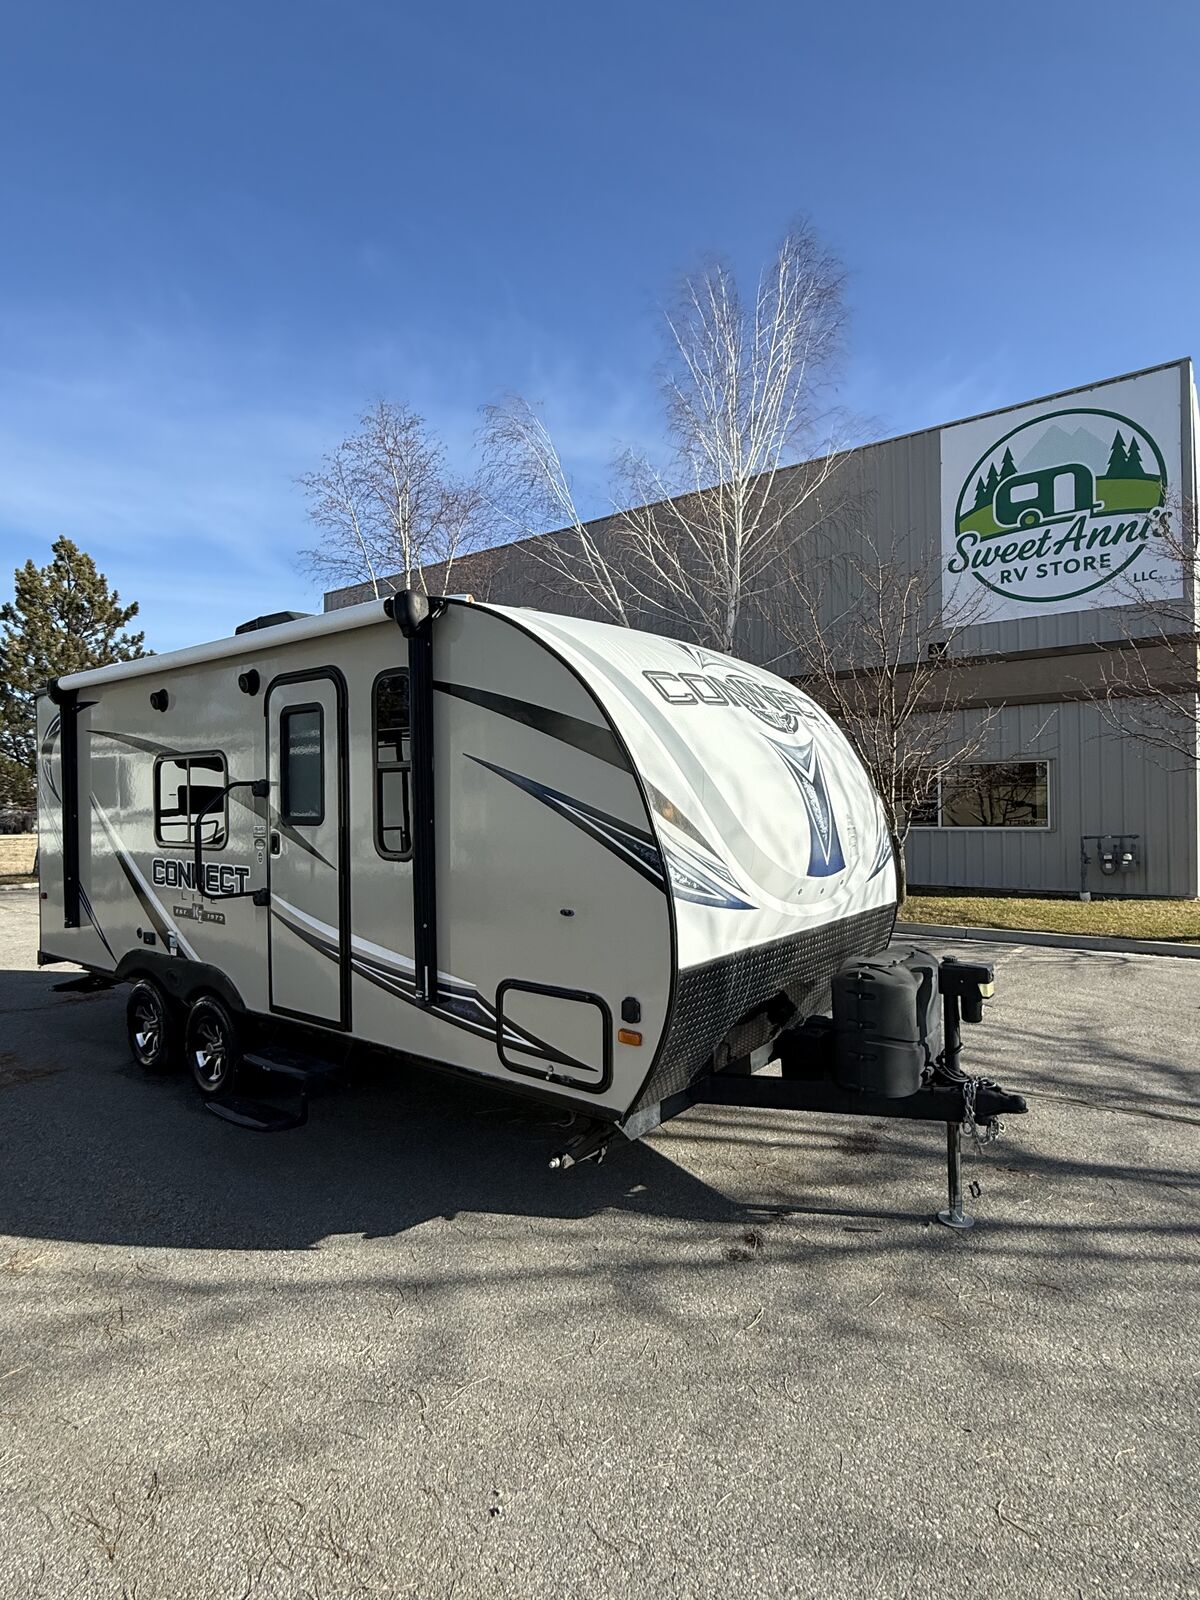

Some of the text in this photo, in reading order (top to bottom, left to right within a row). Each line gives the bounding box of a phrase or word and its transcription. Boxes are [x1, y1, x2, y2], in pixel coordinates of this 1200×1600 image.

[947, 528, 1052, 574] Sweet
[1000, 553, 1111, 584] RV STORE
[1133, 569, 1158, 582] LLC
